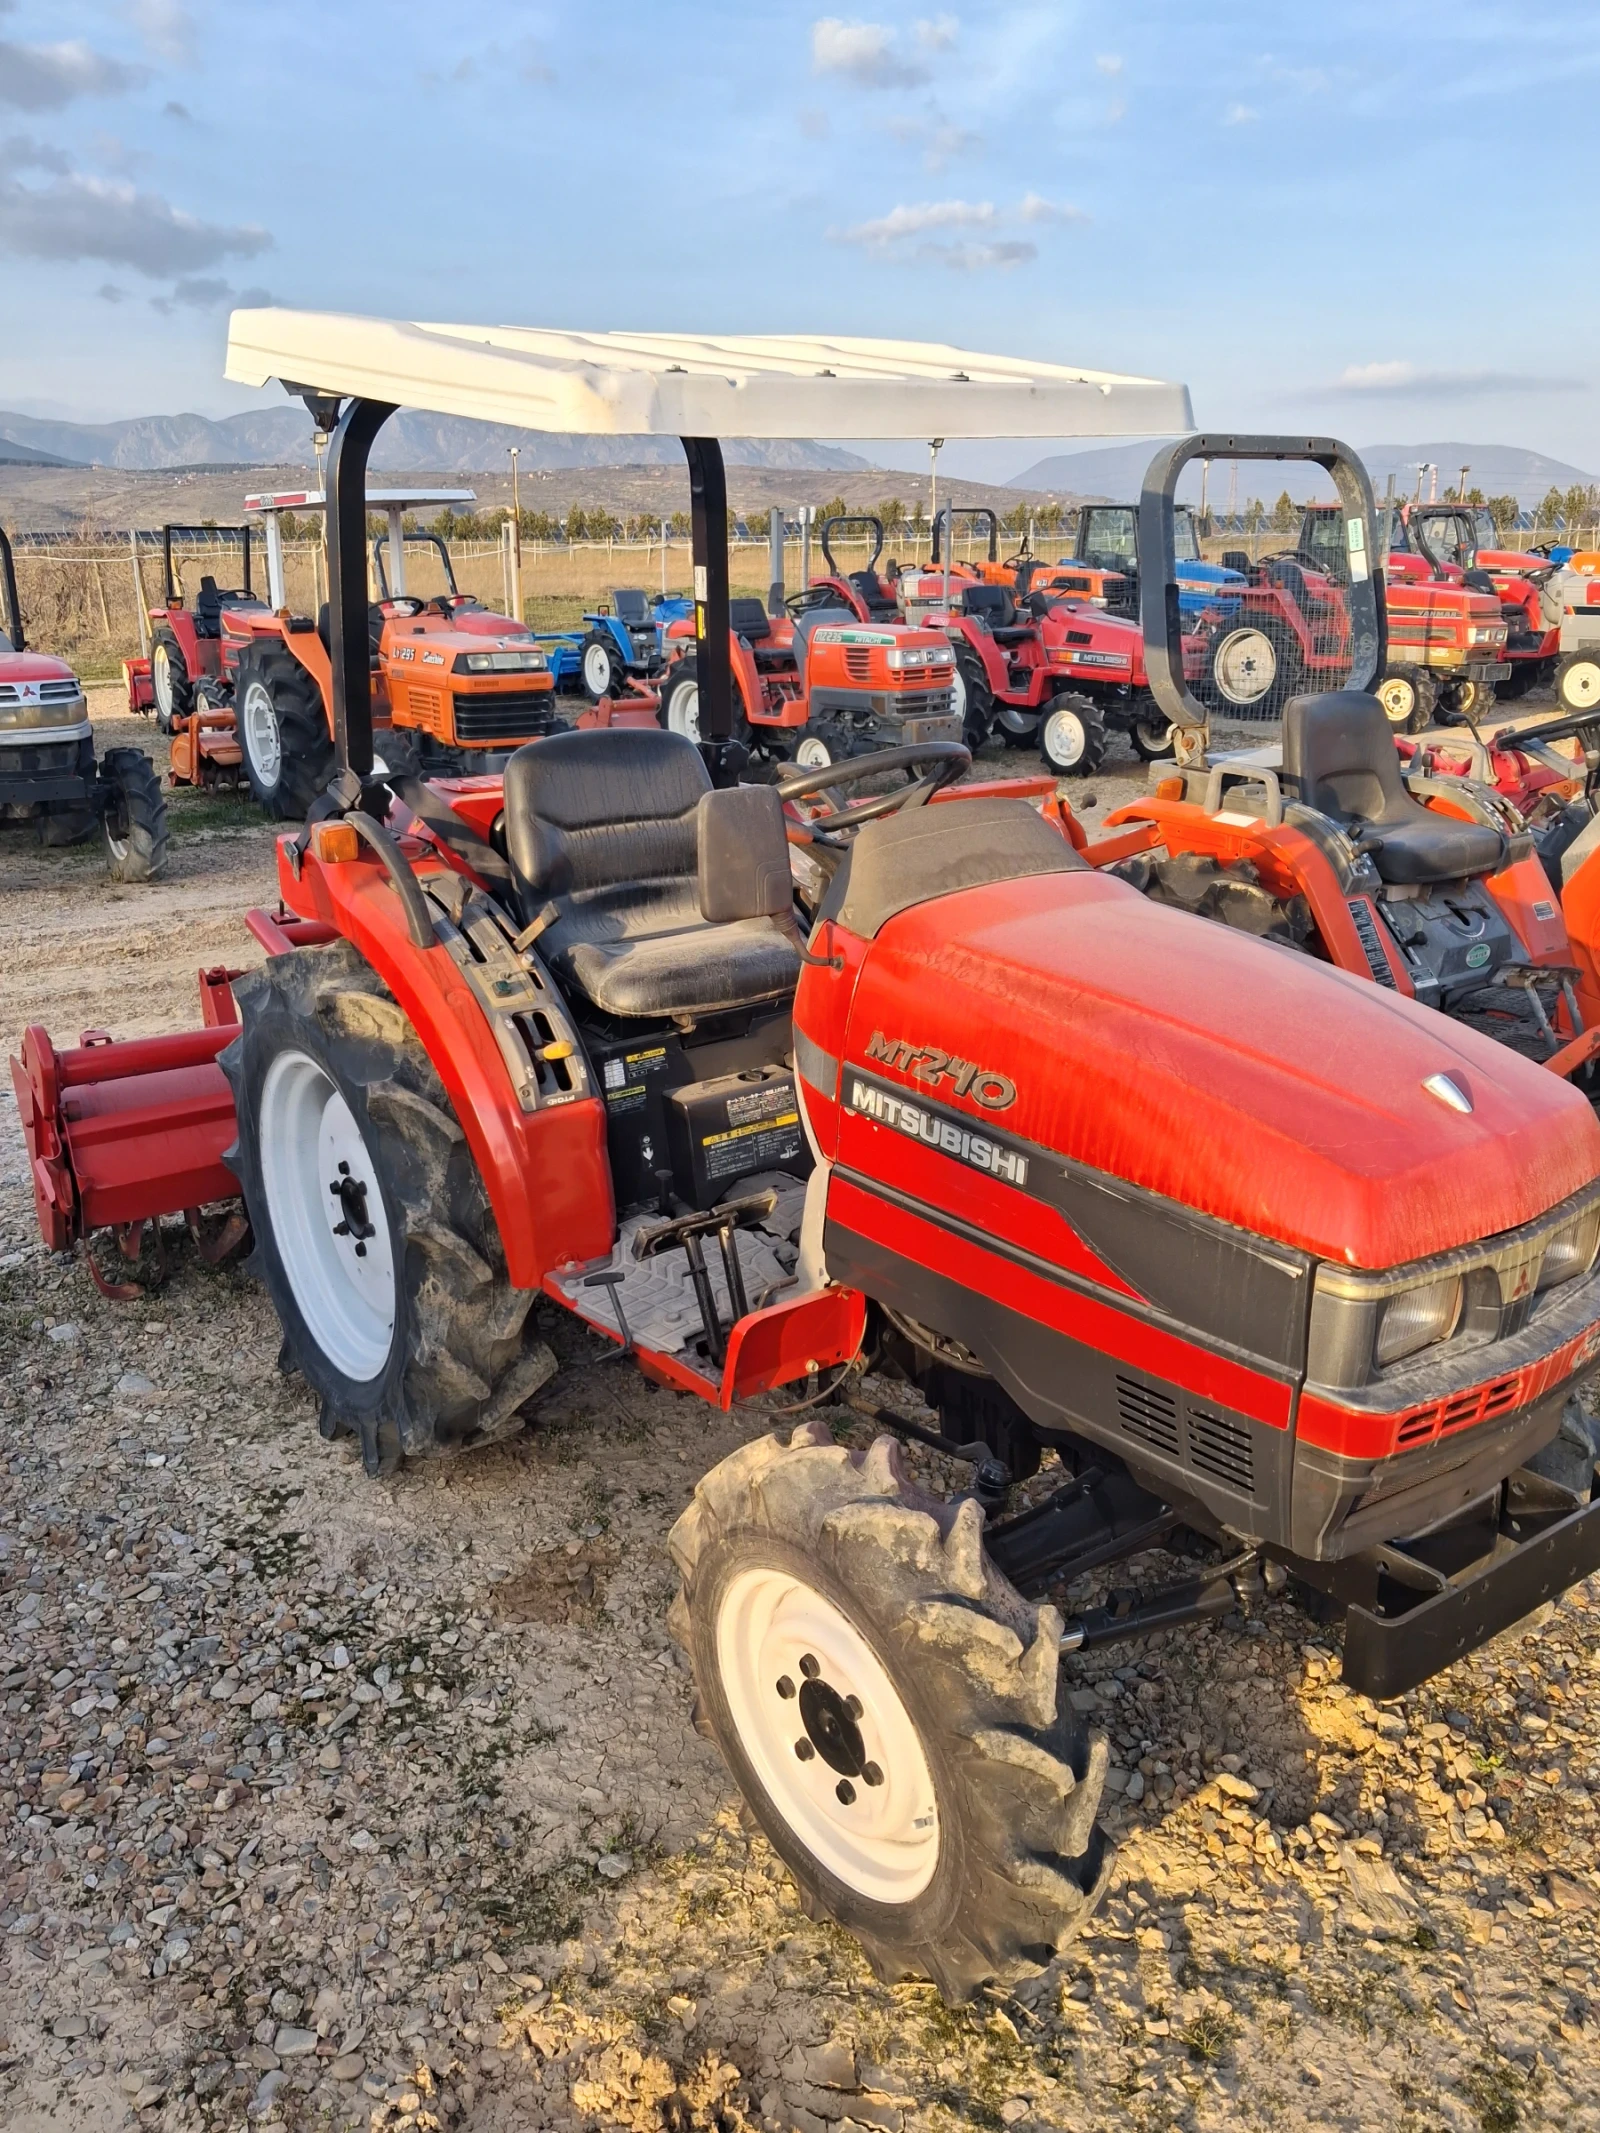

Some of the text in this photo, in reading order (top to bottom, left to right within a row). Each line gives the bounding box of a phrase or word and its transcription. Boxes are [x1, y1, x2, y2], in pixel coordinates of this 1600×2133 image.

[1418, 610, 1457, 618] YANMAR
[855, 636, 882, 644] HITACHI
[1083, 654, 1128, 665] MITSUBISHI
[865, 1032, 1016, 1110] MT240
[852, 1080, 1029, 1185] MITSUBISHI
